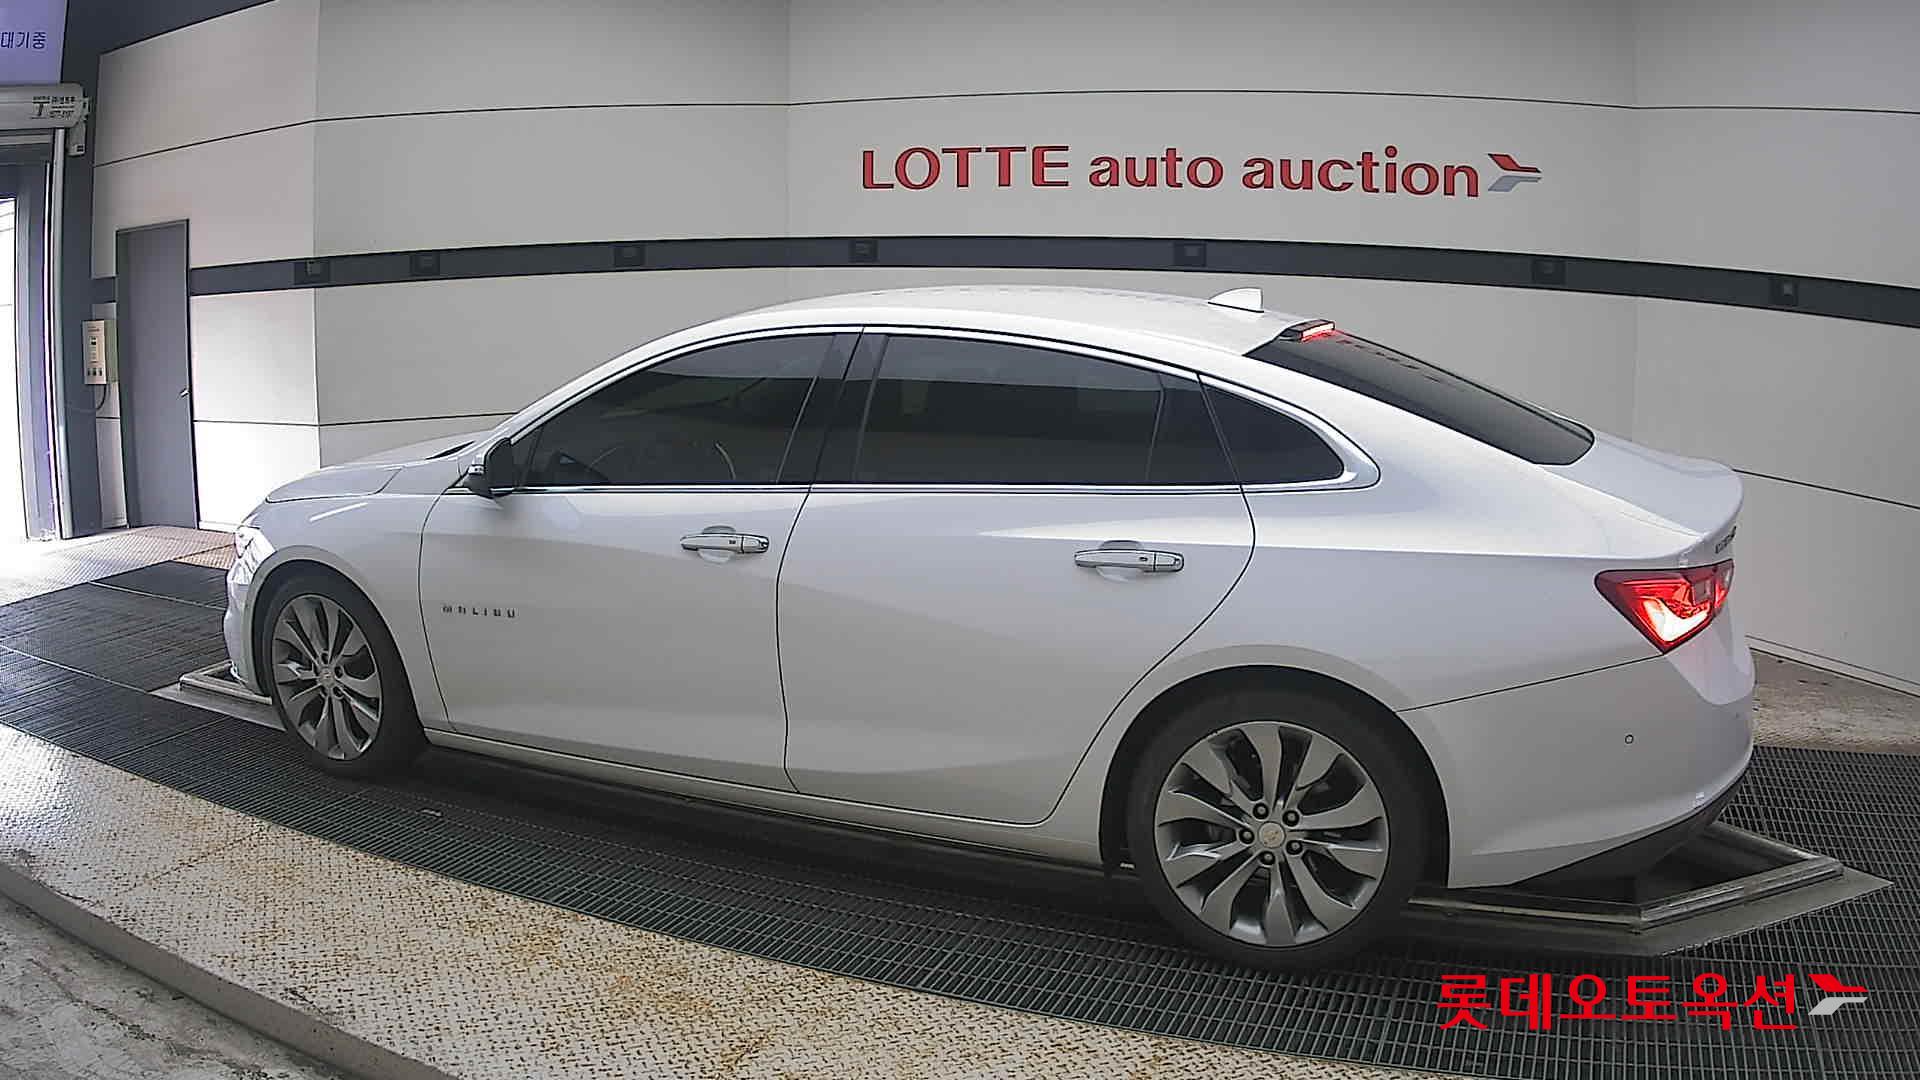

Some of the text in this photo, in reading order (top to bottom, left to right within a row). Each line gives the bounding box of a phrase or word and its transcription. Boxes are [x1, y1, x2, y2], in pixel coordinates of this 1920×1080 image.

[862, 145, 1479, 197] LOTTE auto auction
